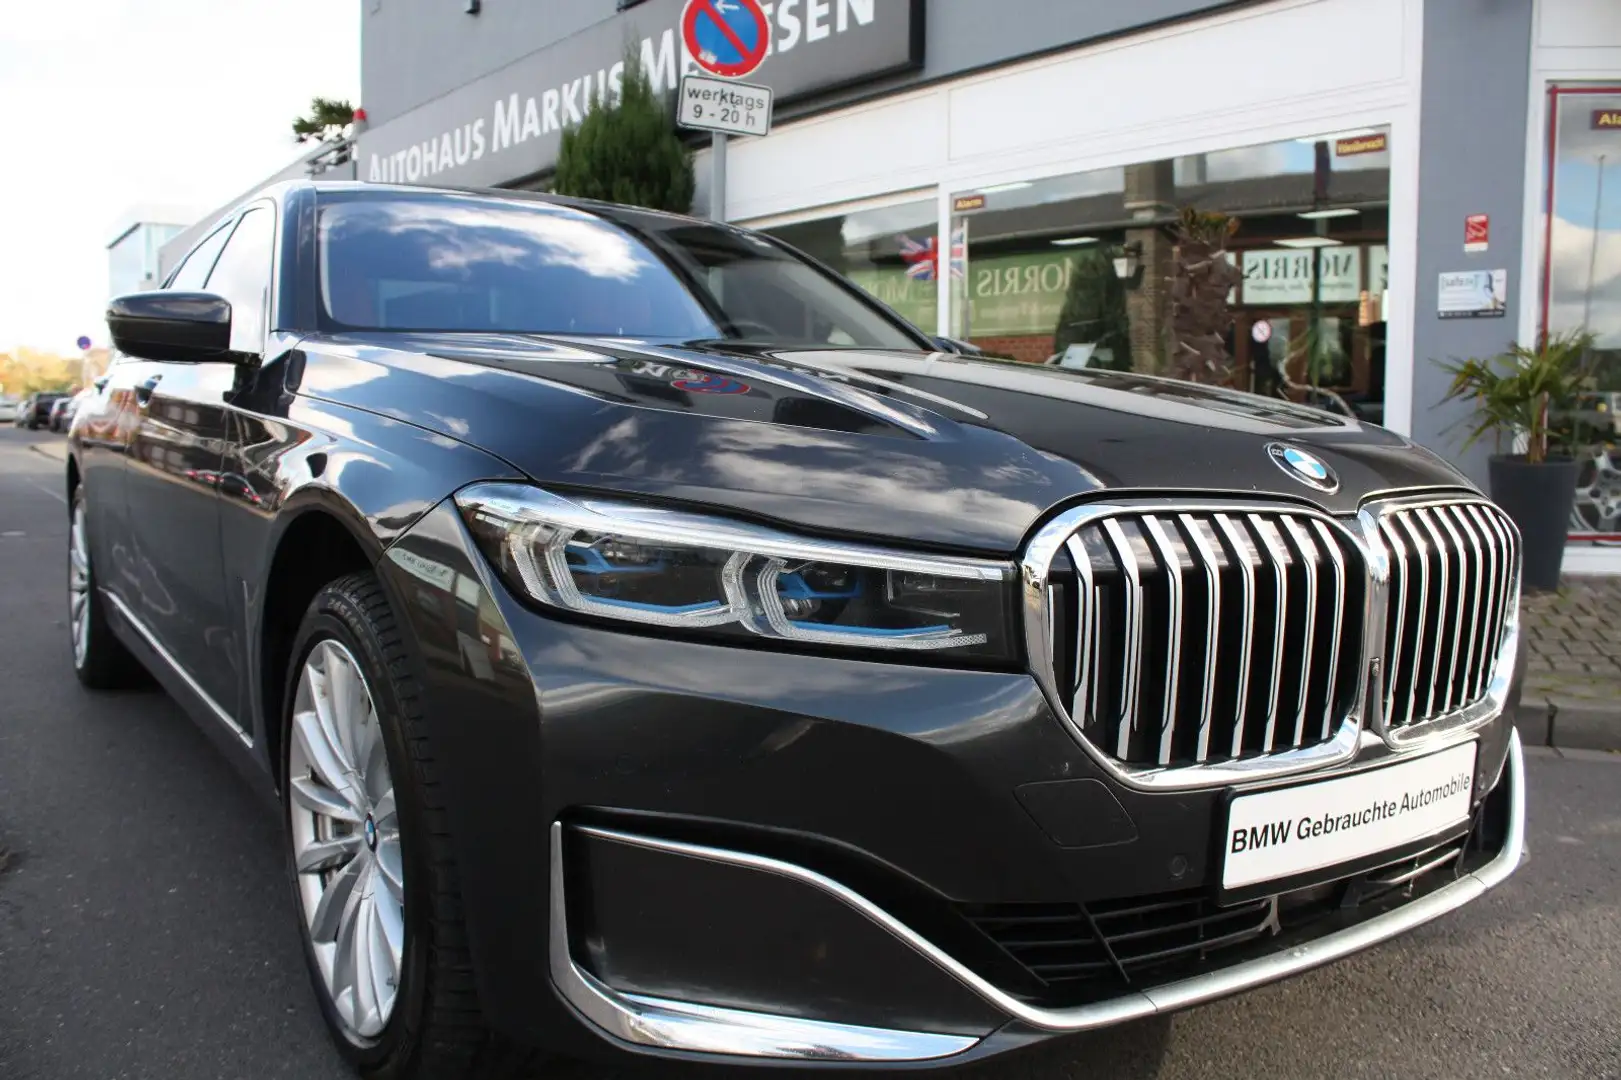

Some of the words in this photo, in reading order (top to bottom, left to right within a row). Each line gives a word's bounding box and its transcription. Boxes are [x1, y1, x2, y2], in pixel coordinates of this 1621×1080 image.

[369, 117, 485, 183] AUTOHAUS
[492, 60, 625, 153] MARKUS
[687, 87, 764, 111] werktags
[692, 104, 703, 119] 9
[720, 107, 740, 124] 20
[746, 111, 757, 126] h
[1231, 819, 1292, 854] BMW
[1296, 800, 1397, 840] Gebrauchte
[1399, 773, 1471, 814] Automobile
